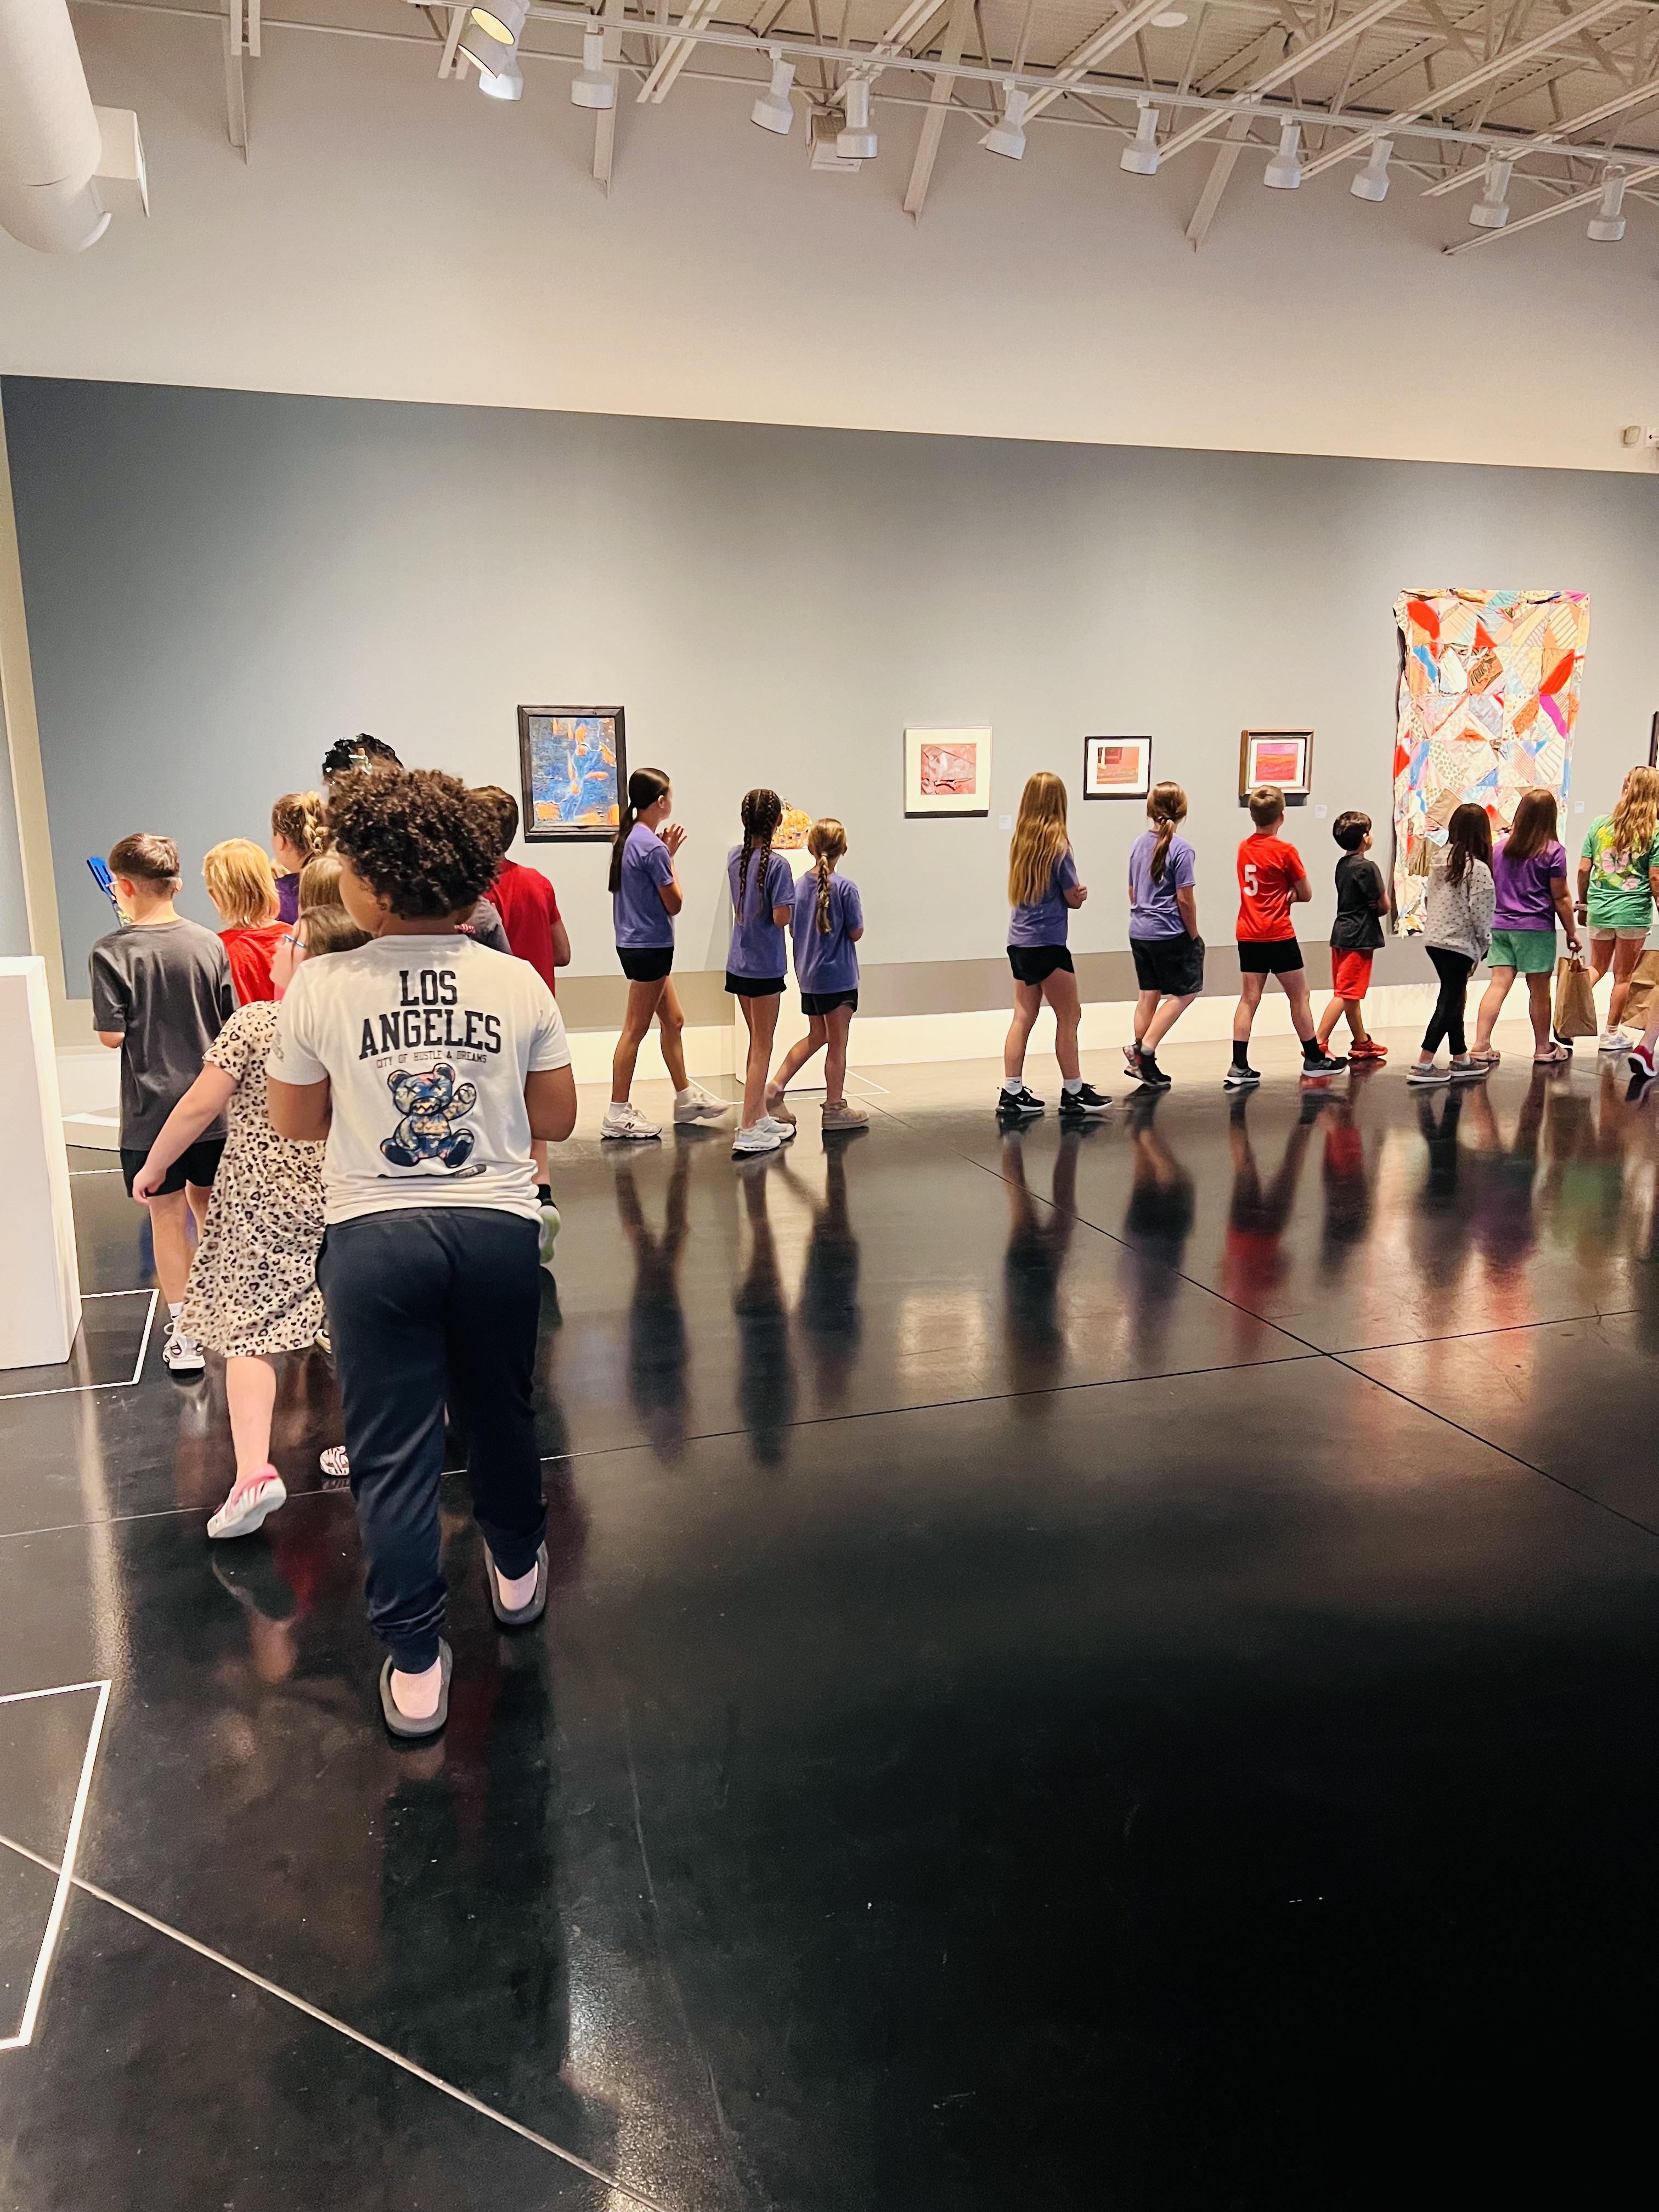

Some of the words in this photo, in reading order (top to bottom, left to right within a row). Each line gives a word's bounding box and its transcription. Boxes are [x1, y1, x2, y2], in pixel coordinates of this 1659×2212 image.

[1243, 864, 1258, 896] 5
[399, 970, 457, 1006] LOS
[359, 1009, 501, 1060] ANGELES
[376, 1057, 392, 1069] CITY
[398, 1053, 408, 1064] OF
[447, 1051, 453, 1059] &
[456, 1051, 487, 1063] DREAMS
